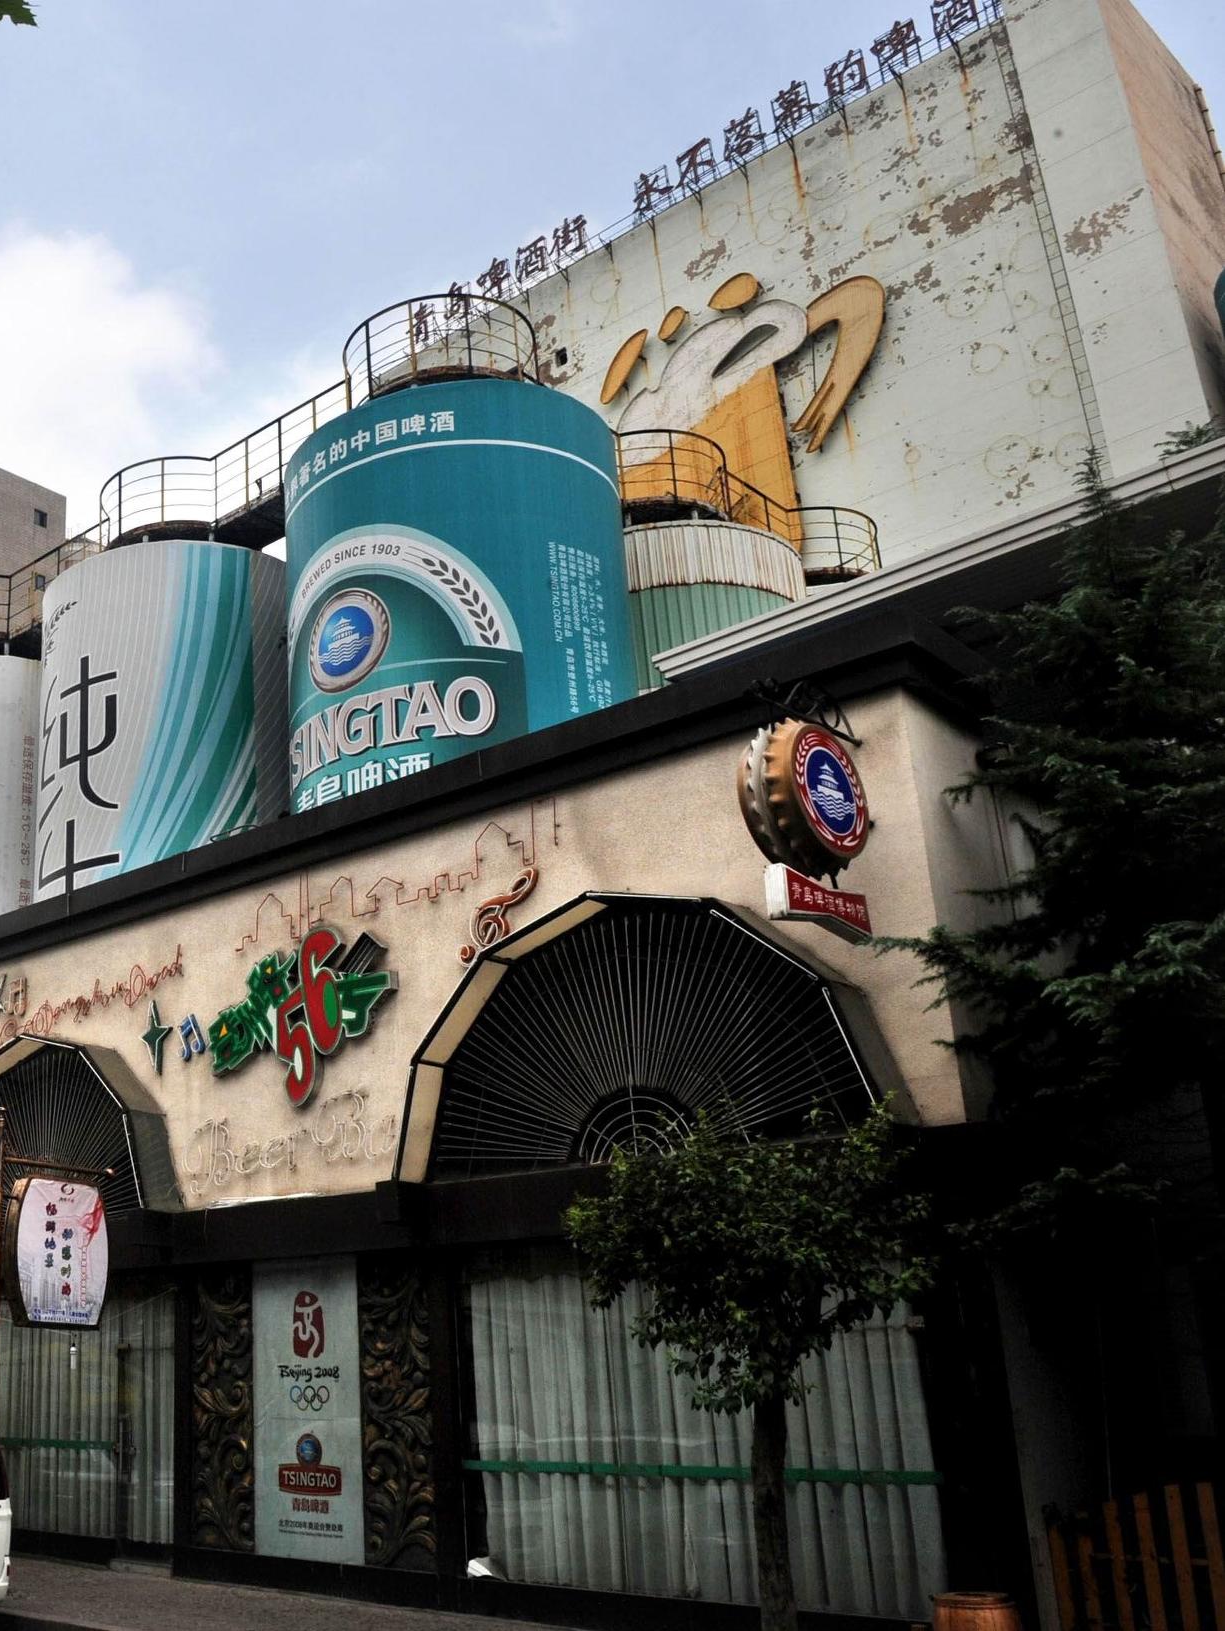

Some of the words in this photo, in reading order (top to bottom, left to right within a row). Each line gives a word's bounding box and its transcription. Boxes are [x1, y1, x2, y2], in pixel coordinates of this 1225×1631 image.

[301, 558, 331, 599] BREWED
[334, 545, 366, 564] SINCE
[371, 544, 401, 557] 1903
[289, 676, 496, 791] SINGTAO
[277, 927, 343, 1108] 56
[278, 1364, 312, 1382] Beijing
[314, 1365, 340, 1380] 2008
[282, 1470, 337, 1489] TSINGTAO
